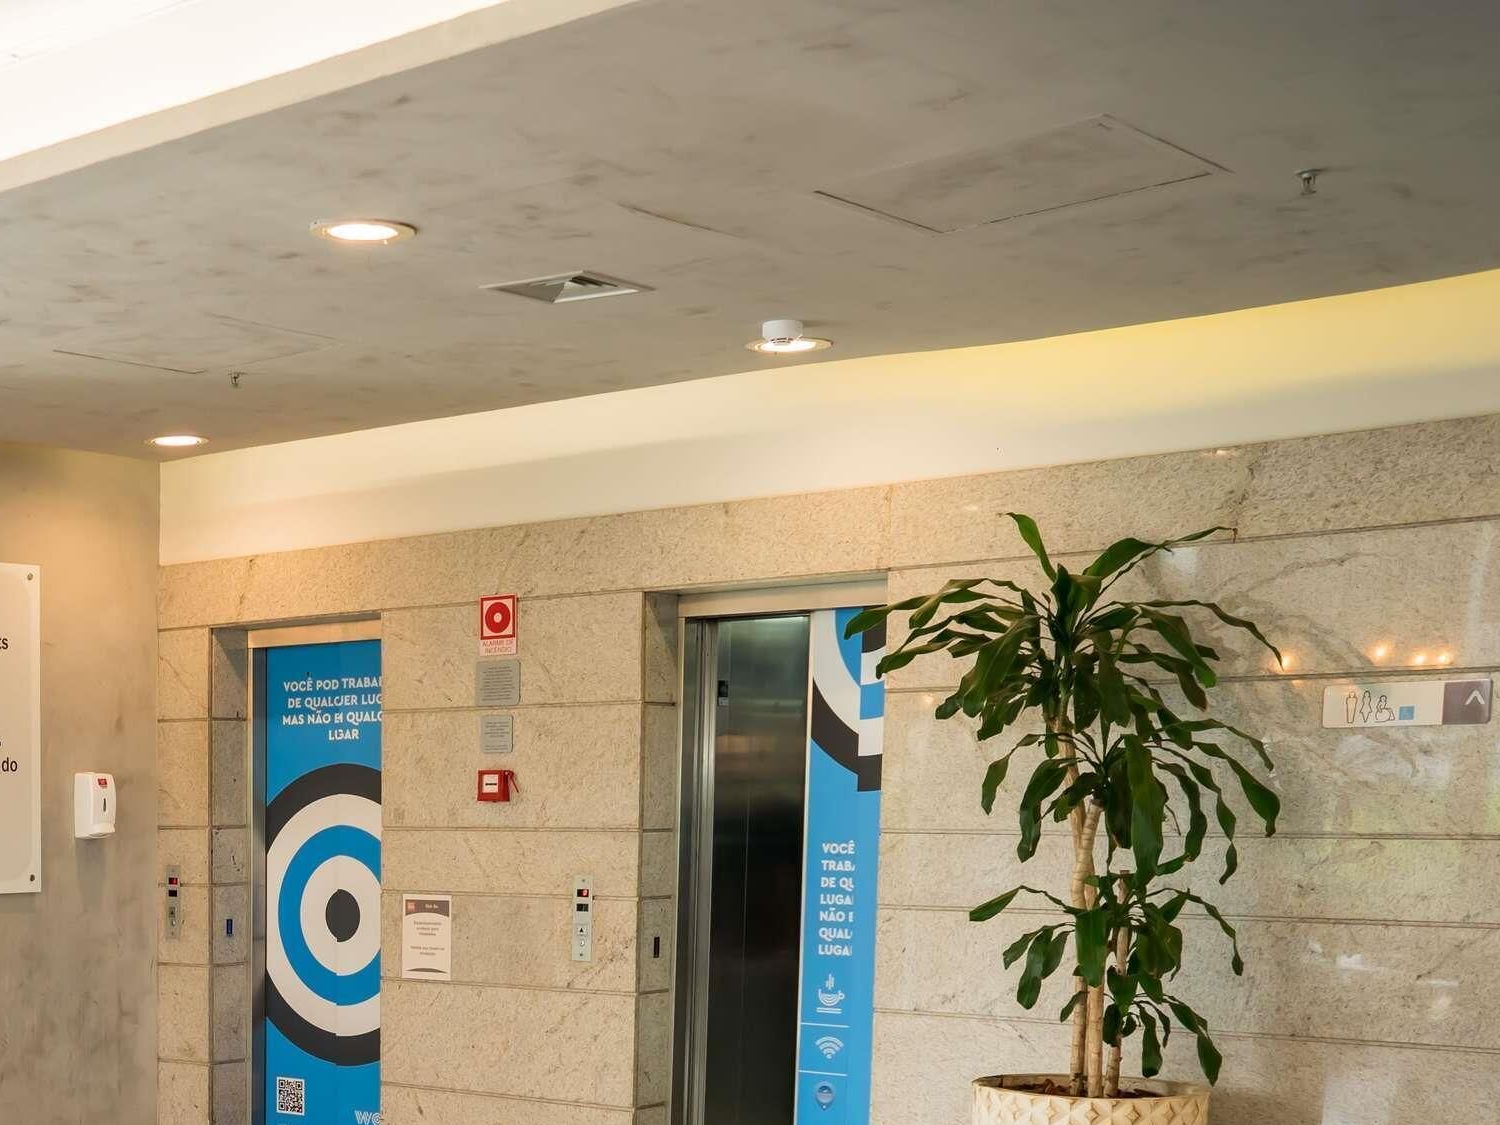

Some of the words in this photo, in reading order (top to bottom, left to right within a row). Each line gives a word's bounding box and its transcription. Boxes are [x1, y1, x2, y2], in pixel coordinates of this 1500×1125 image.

[284, 677, 313, 691] VOCÊ
[341, 677, 382, 688] TRABA
[288, 698, 301, 708] DE
[283, 715, 304, 725] MAS
[307, 710, 330, 724] NÃO
[2, 758, 18, 773] do
[822, 840, 855, 854] VOCÊ
[821, 877, 836, 887] DE
[820, 907, 845, 922] NÃO
